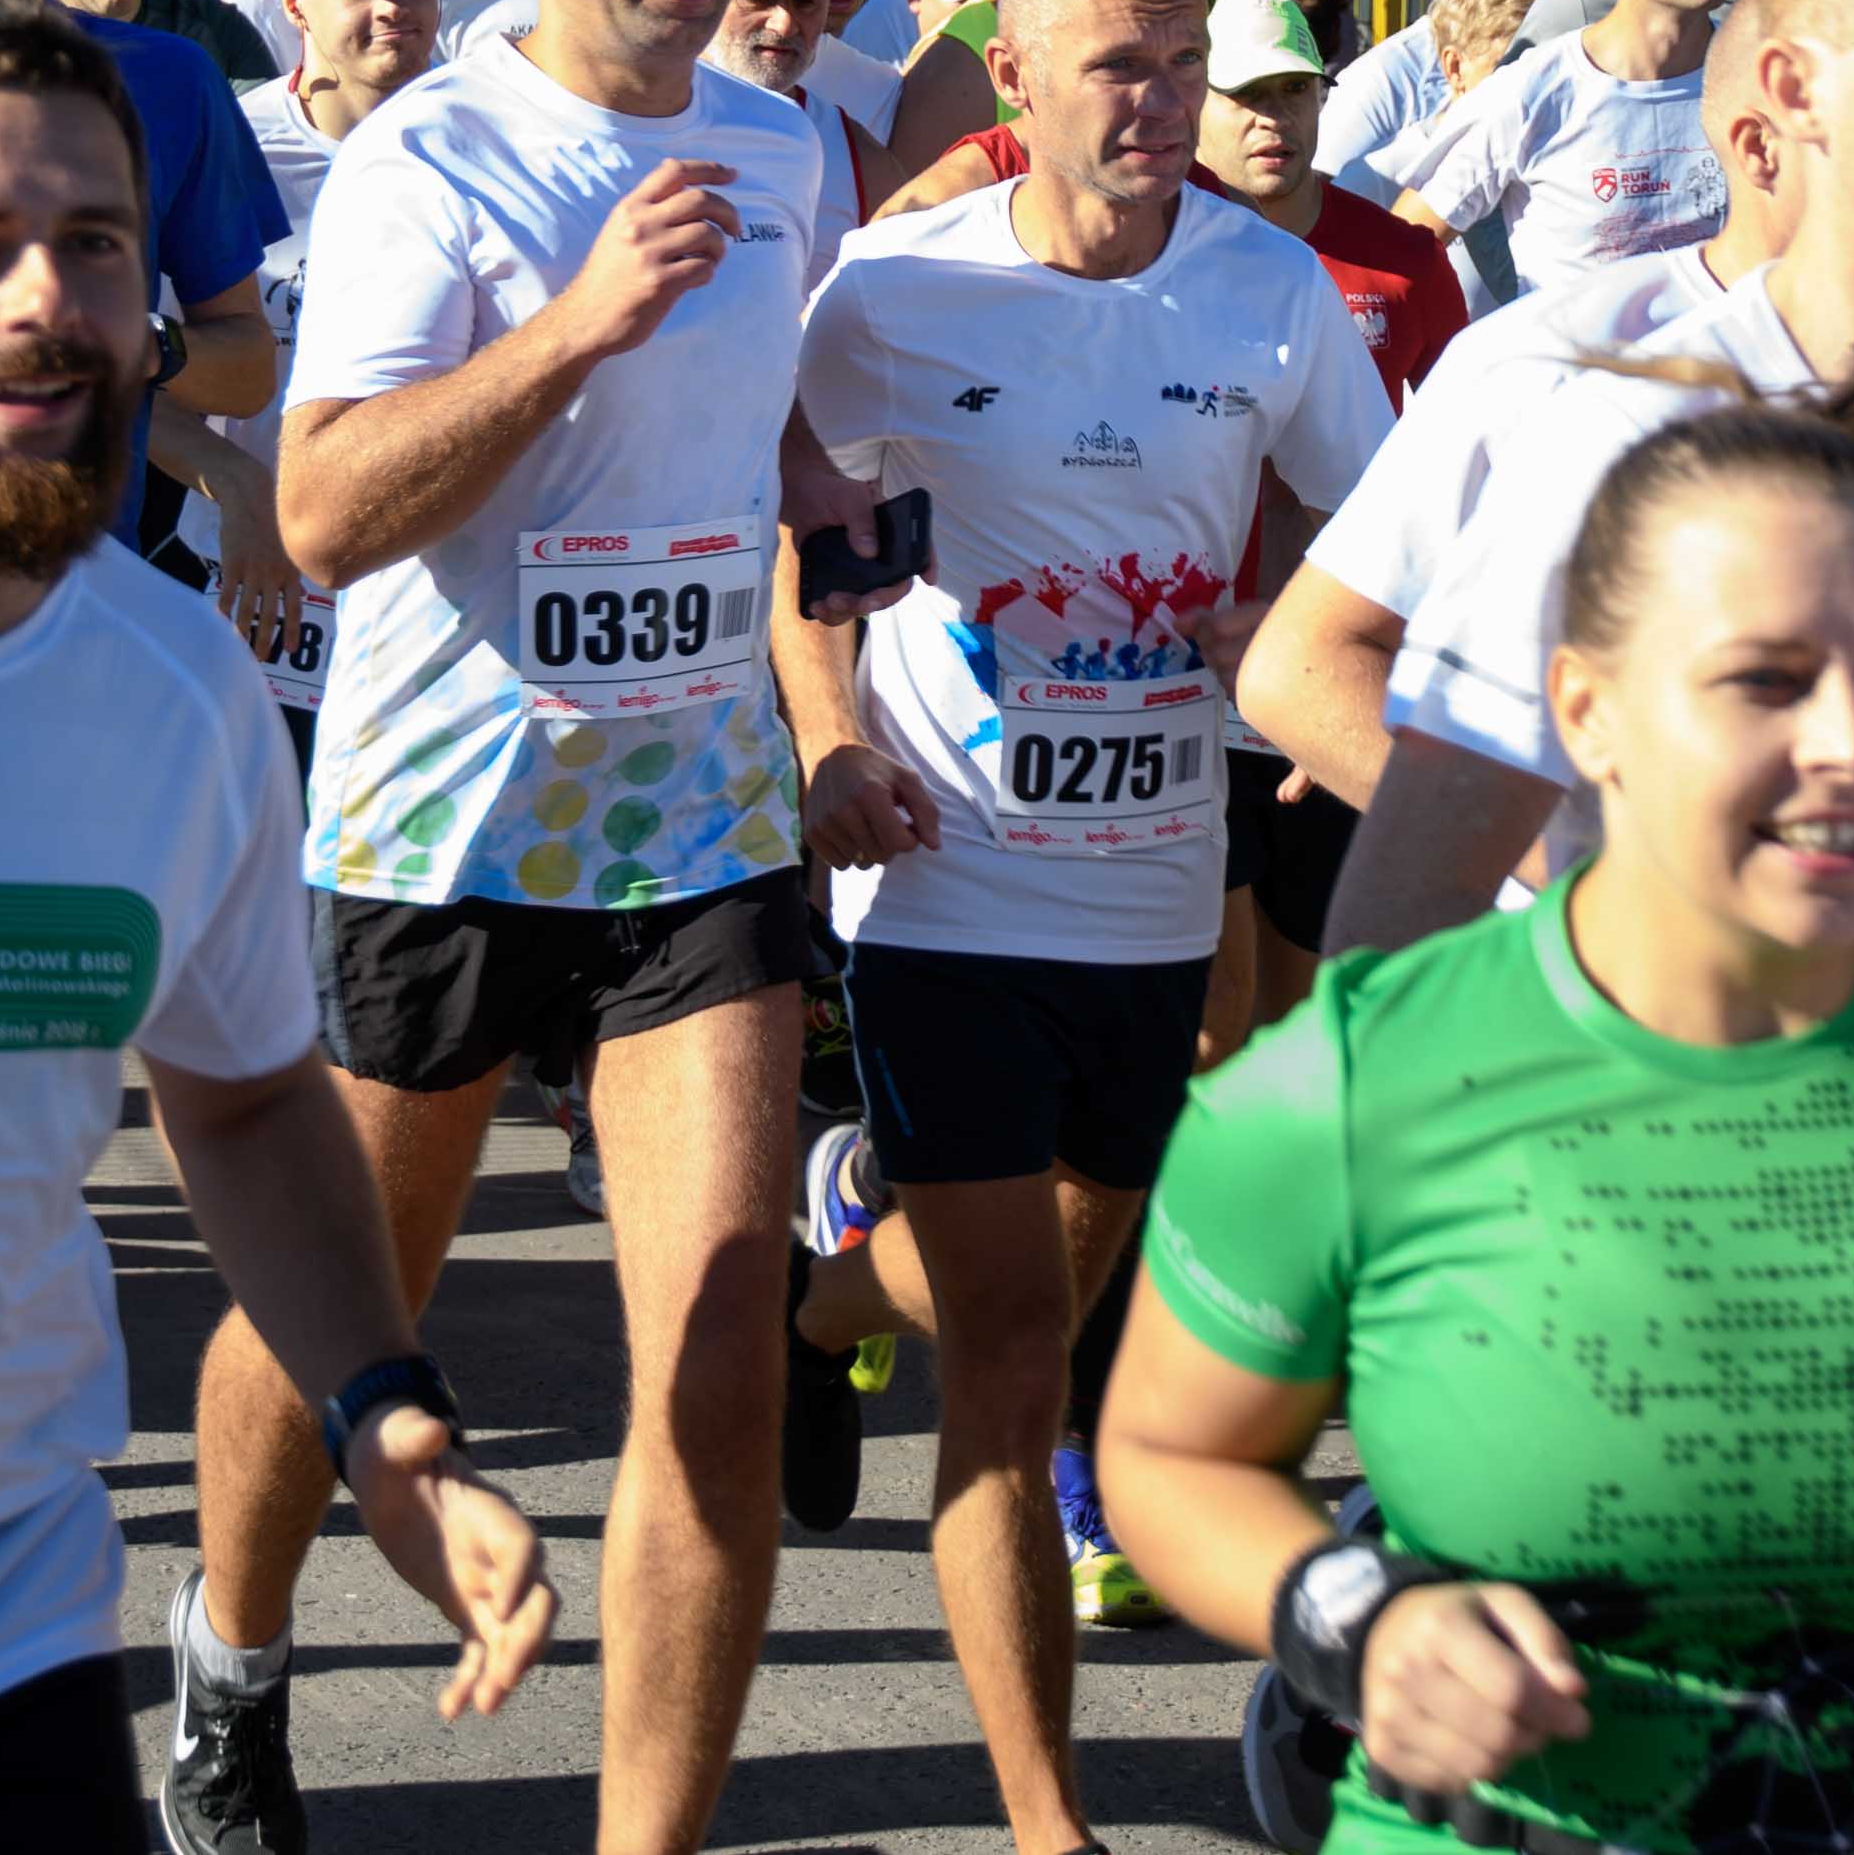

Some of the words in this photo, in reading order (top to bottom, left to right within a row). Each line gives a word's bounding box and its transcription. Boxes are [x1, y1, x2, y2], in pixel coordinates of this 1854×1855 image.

[1620, 171, 1650, 183] RUN
[1622, 177, 1671, 195] TORUŃ
[952, 386, 1001, 413] 4F
[562, 536, 630, 552] EPROS
[534, 582, 711, 667] 0339
[1046, 684, 1108, 702] EPROS
[1012, 732, 1165, 804] 0275
